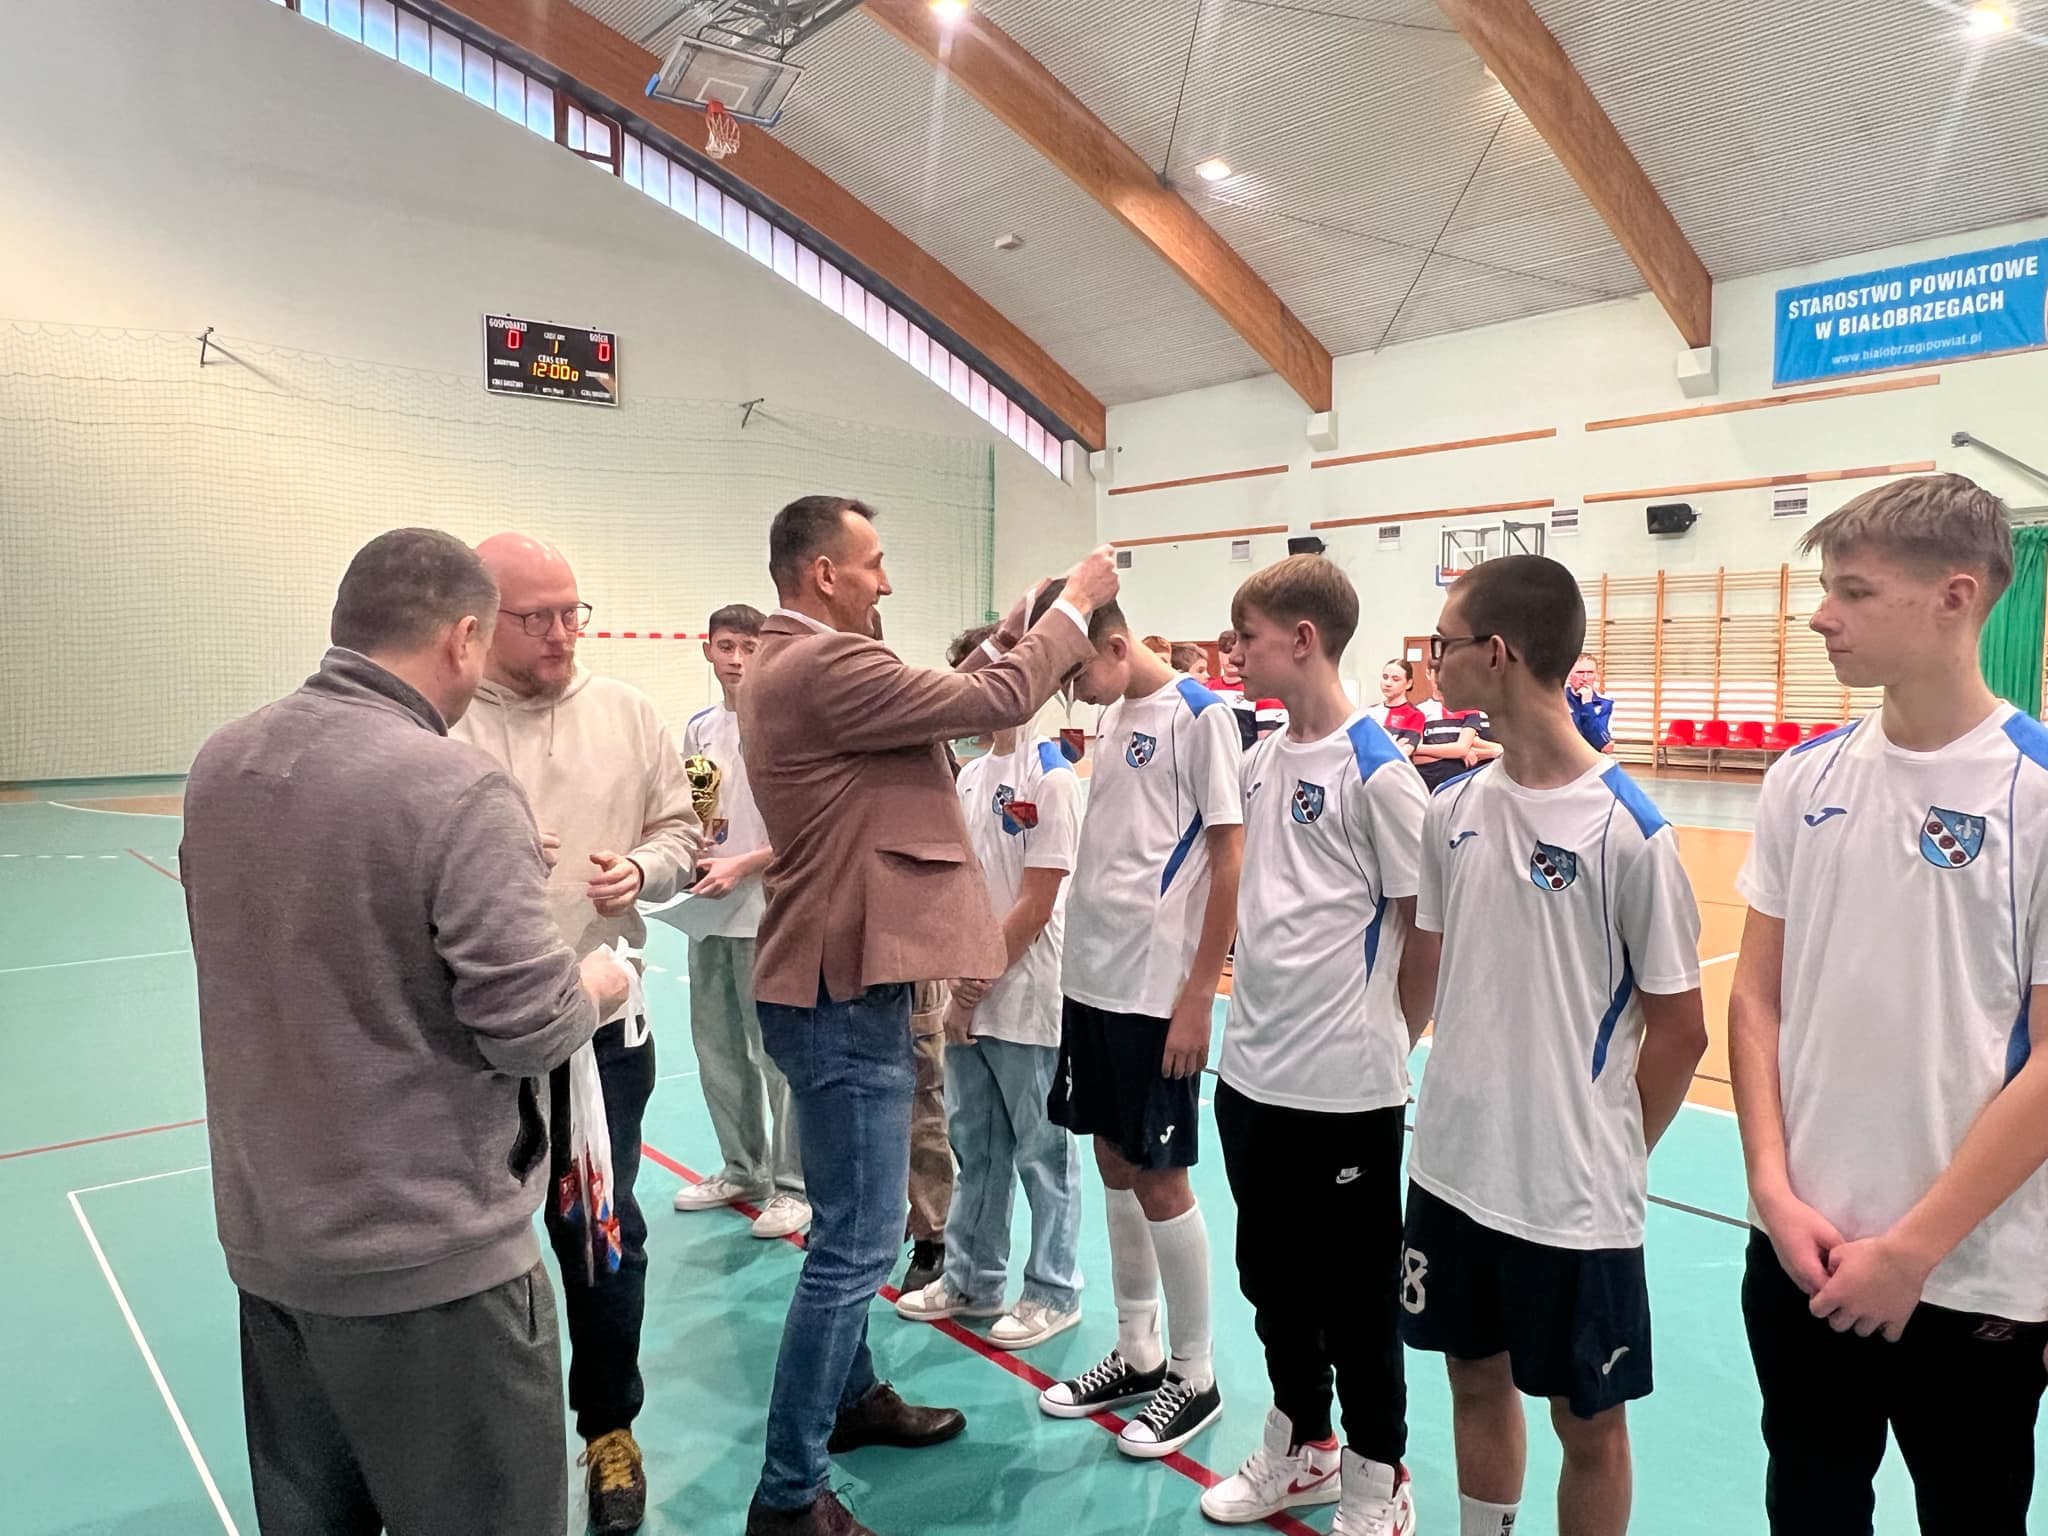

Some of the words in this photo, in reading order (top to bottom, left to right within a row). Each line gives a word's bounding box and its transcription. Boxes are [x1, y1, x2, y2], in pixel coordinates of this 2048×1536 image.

[1788, 281, 1902, 320] STAROSTWO
[1909, 256, 2039, 298] POWIATOWE
[1815, 319, 1832, 340] W
[1838, 290, 2005, 336] BIAŁOBRZEGACH
[507, 330, 520, 349] 0
[598, 343, 610, 362] 0
